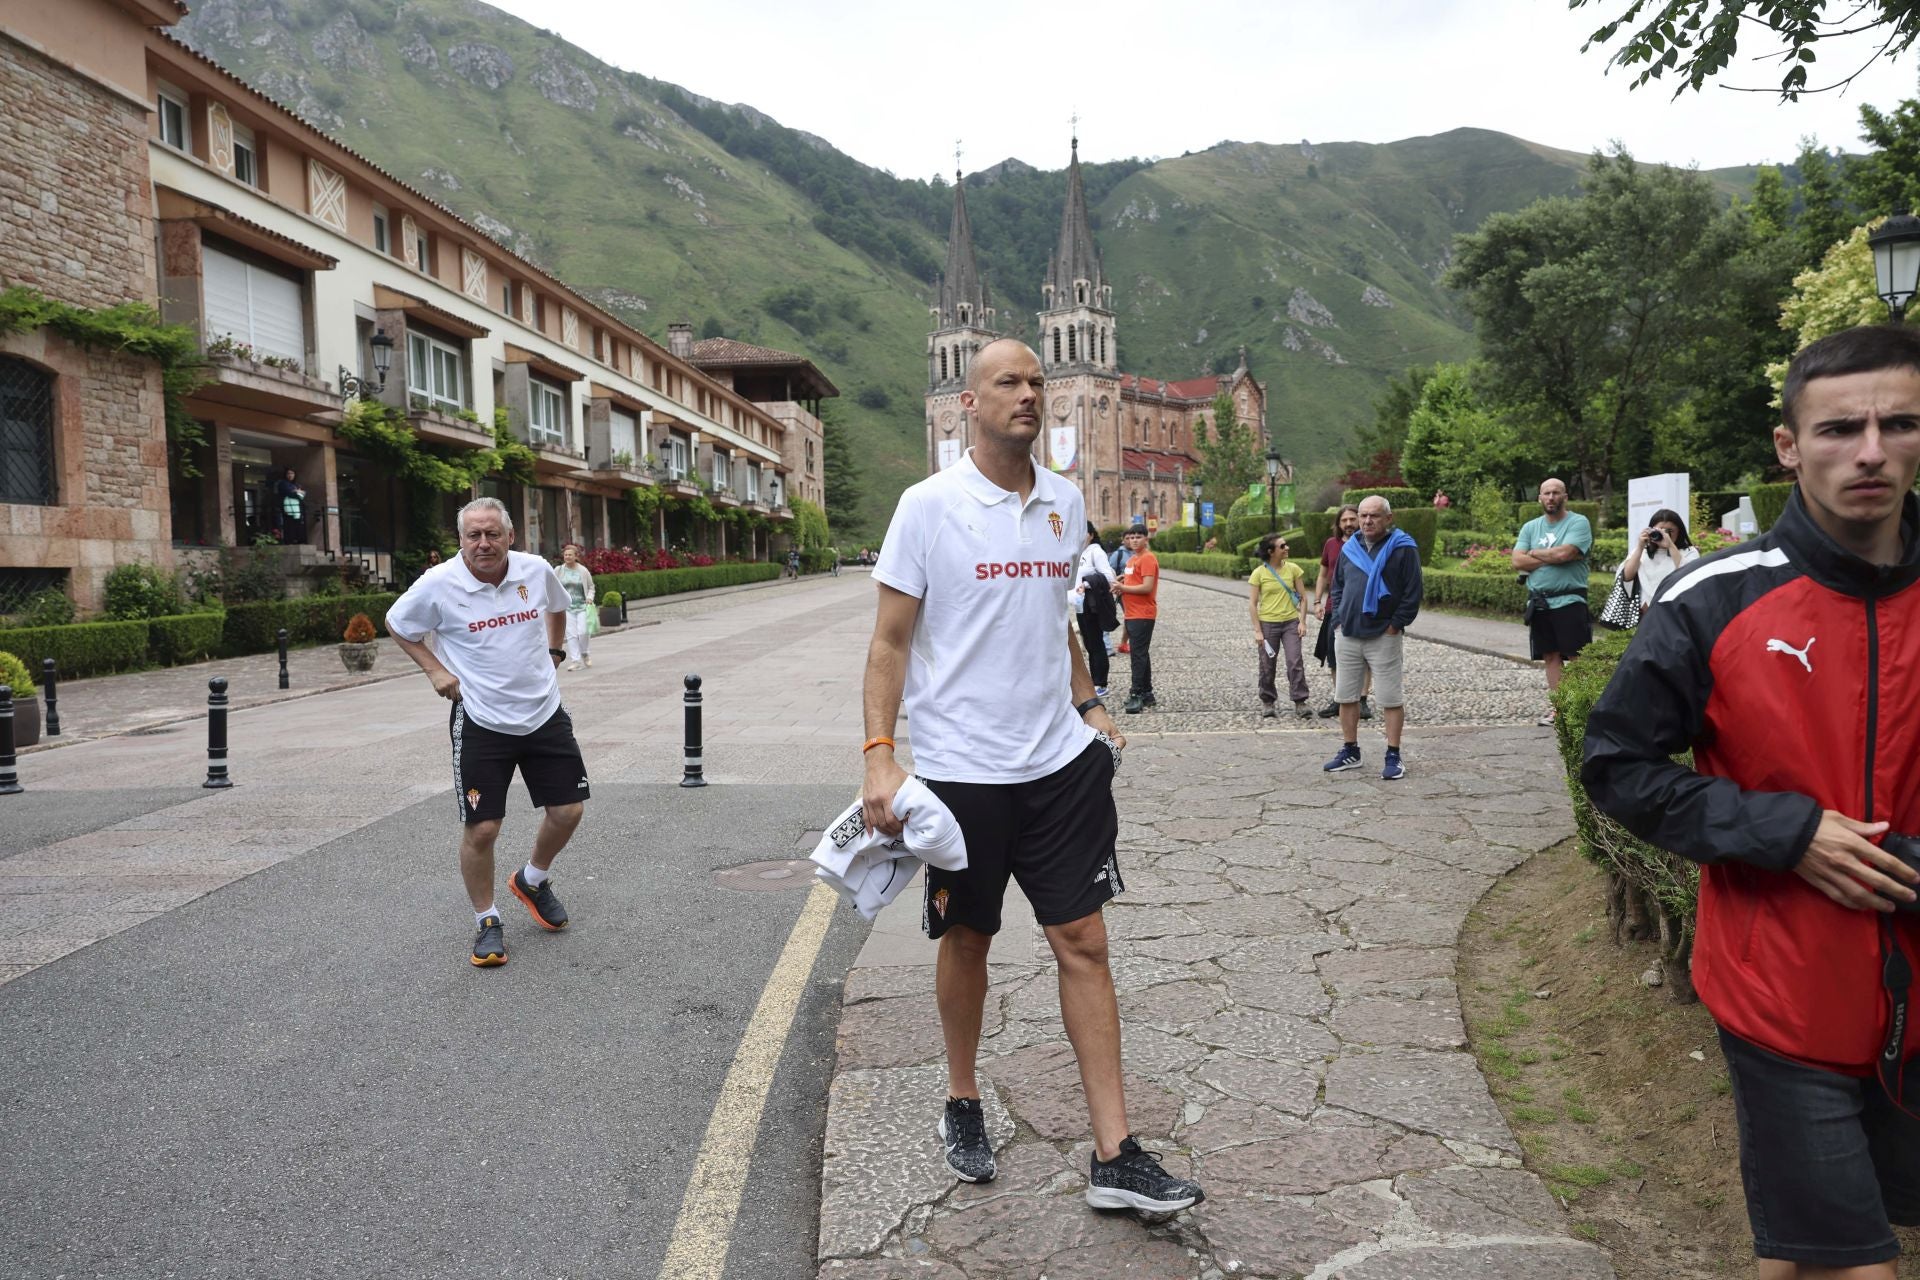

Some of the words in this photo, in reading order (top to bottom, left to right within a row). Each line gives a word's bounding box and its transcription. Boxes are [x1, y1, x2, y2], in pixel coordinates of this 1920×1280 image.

[975, 561, 1070, 580] SPORTING
[468, 608, 539, 633] SPORTING
[1884, 1002, 1905, 1060] Canon
